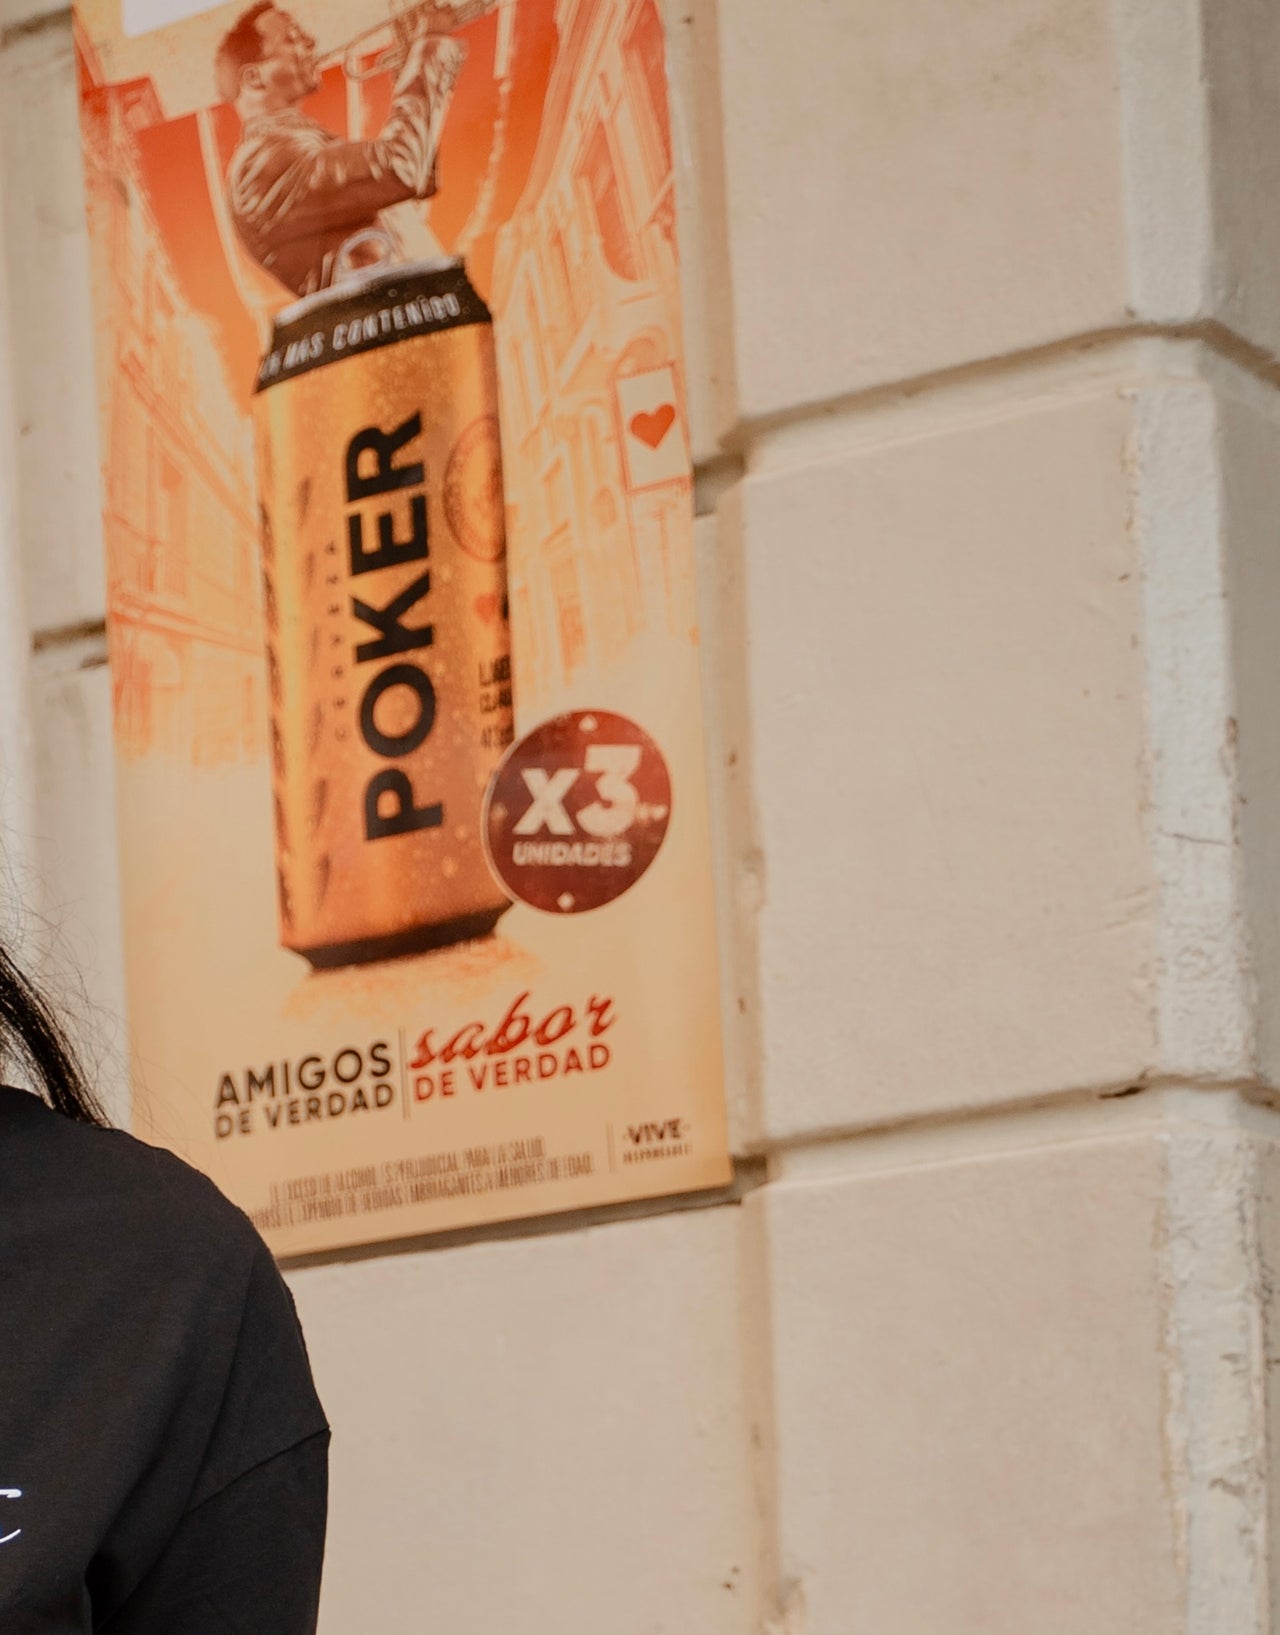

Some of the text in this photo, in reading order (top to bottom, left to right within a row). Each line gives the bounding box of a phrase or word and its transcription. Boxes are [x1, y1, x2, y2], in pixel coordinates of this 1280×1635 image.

[345, 410, 444, 842] POKER
[512, 840, 633, 868] UNIDADES
[409, 991, 614, 1070] sabor
[216, 1042, 392, 1109] AMIGOS
[414, 1043, 612, 1103] DE VERDAD
[215, 1082, 395, 1140] DE VERDAD
[627, 1117, 681, 1145] VIVE
